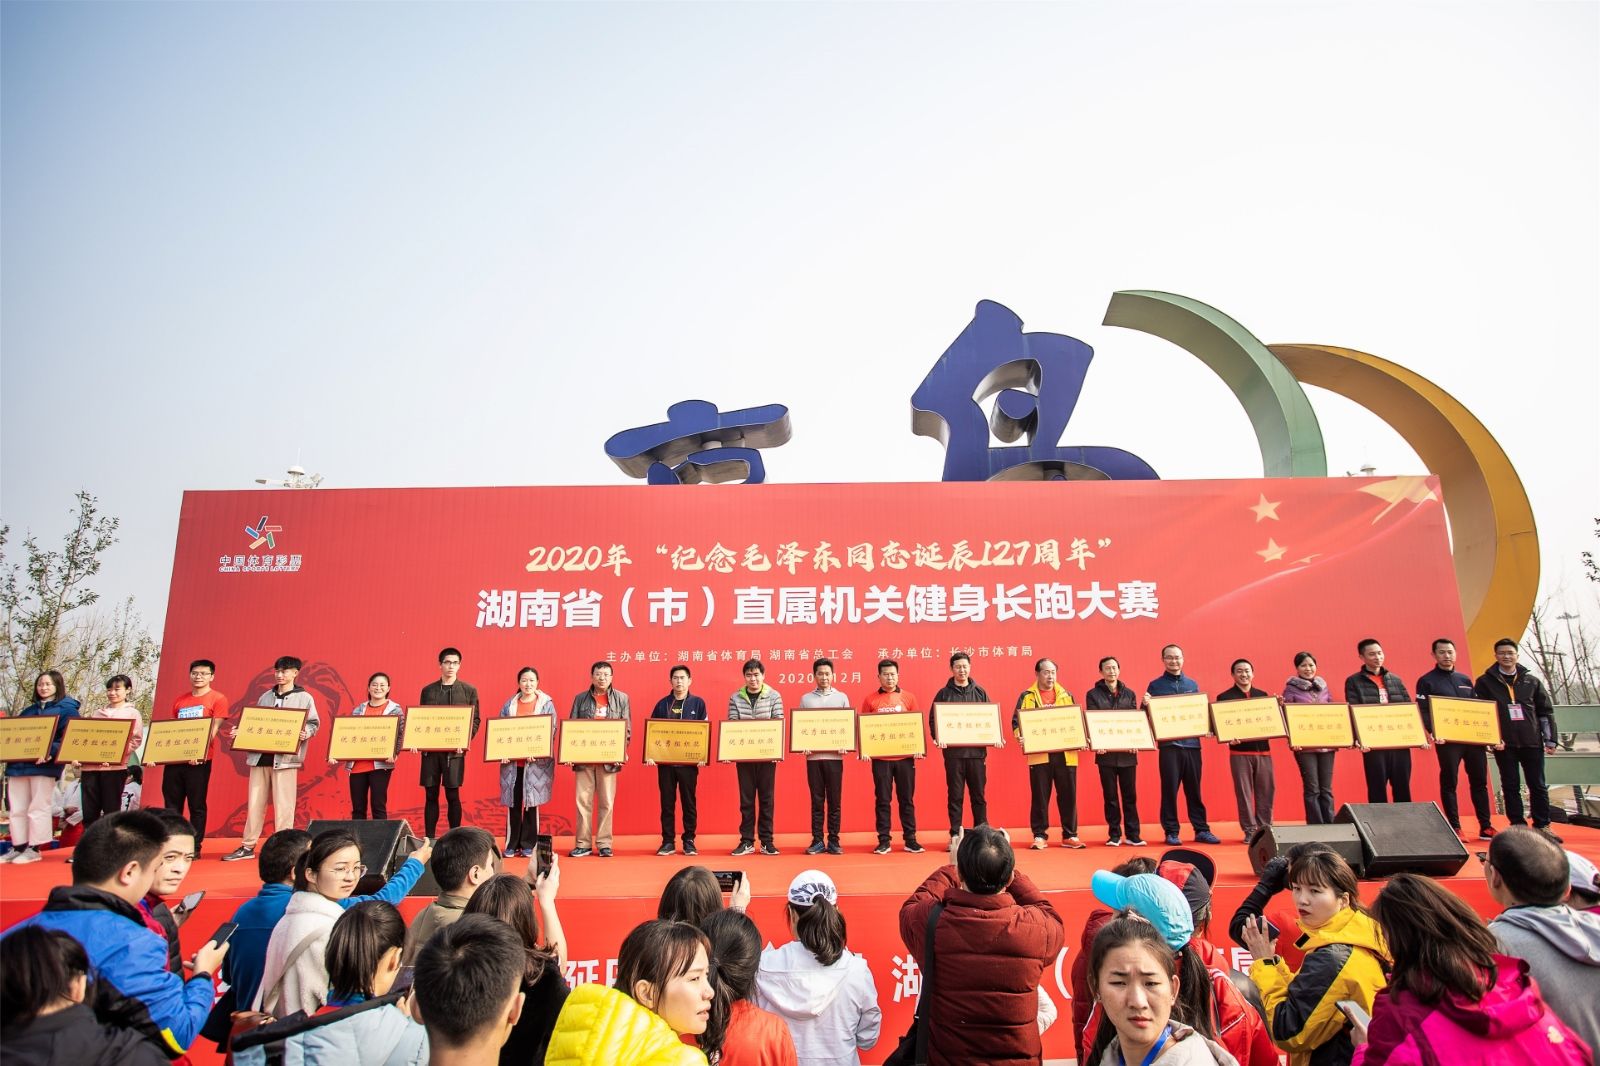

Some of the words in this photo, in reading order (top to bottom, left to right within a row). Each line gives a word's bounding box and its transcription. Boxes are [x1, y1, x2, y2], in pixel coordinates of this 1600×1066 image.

[525, 544, 632, 576] 2020年
[475, 580, 1159, 628] 湖南省（市）直属机关健身长跑大赛
